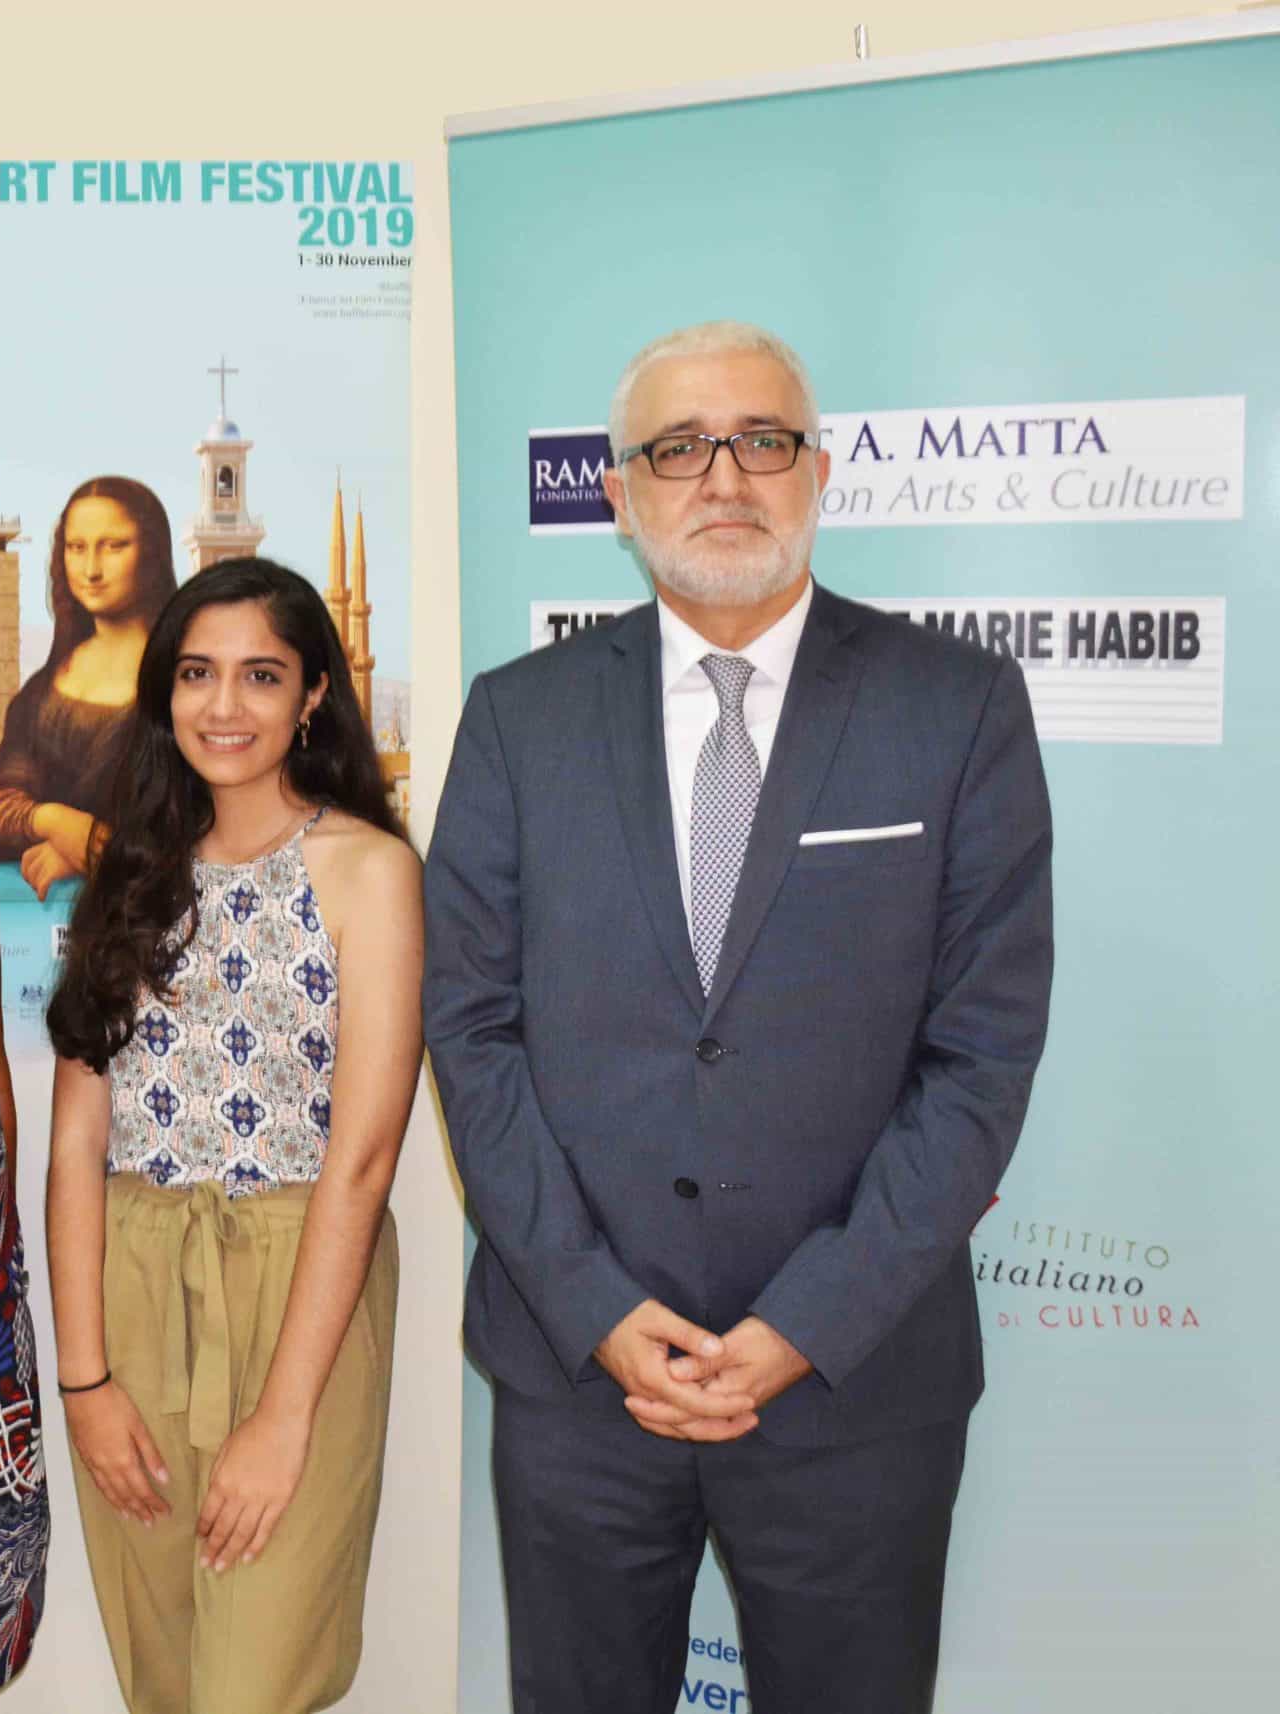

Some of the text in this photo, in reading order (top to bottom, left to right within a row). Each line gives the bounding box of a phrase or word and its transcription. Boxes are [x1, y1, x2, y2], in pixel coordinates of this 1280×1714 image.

[72, 161, 182, 203] FILM
[200, 161, 414, 204] FESTIVAL
[298, 206, 414, 248] 2019
[338, 251, 412, 267] November
[849, 420, 894, 462] A.
[917, 414, 1110, 460] MATTA
[535, 457, 606, 489] RAM
[888, 474, 977, 513] Arts
[996, 471, 1032, 511] &
[1050, 465, 1230, 510] Culture
[1068, 611, 1201, 660] HABIB
[1012, 1220, 1170, 1270] ISTITUTO
[975, 1253, 1144, 1297] italiano
[1038, 1304, 1201, 1329] CULTURA
